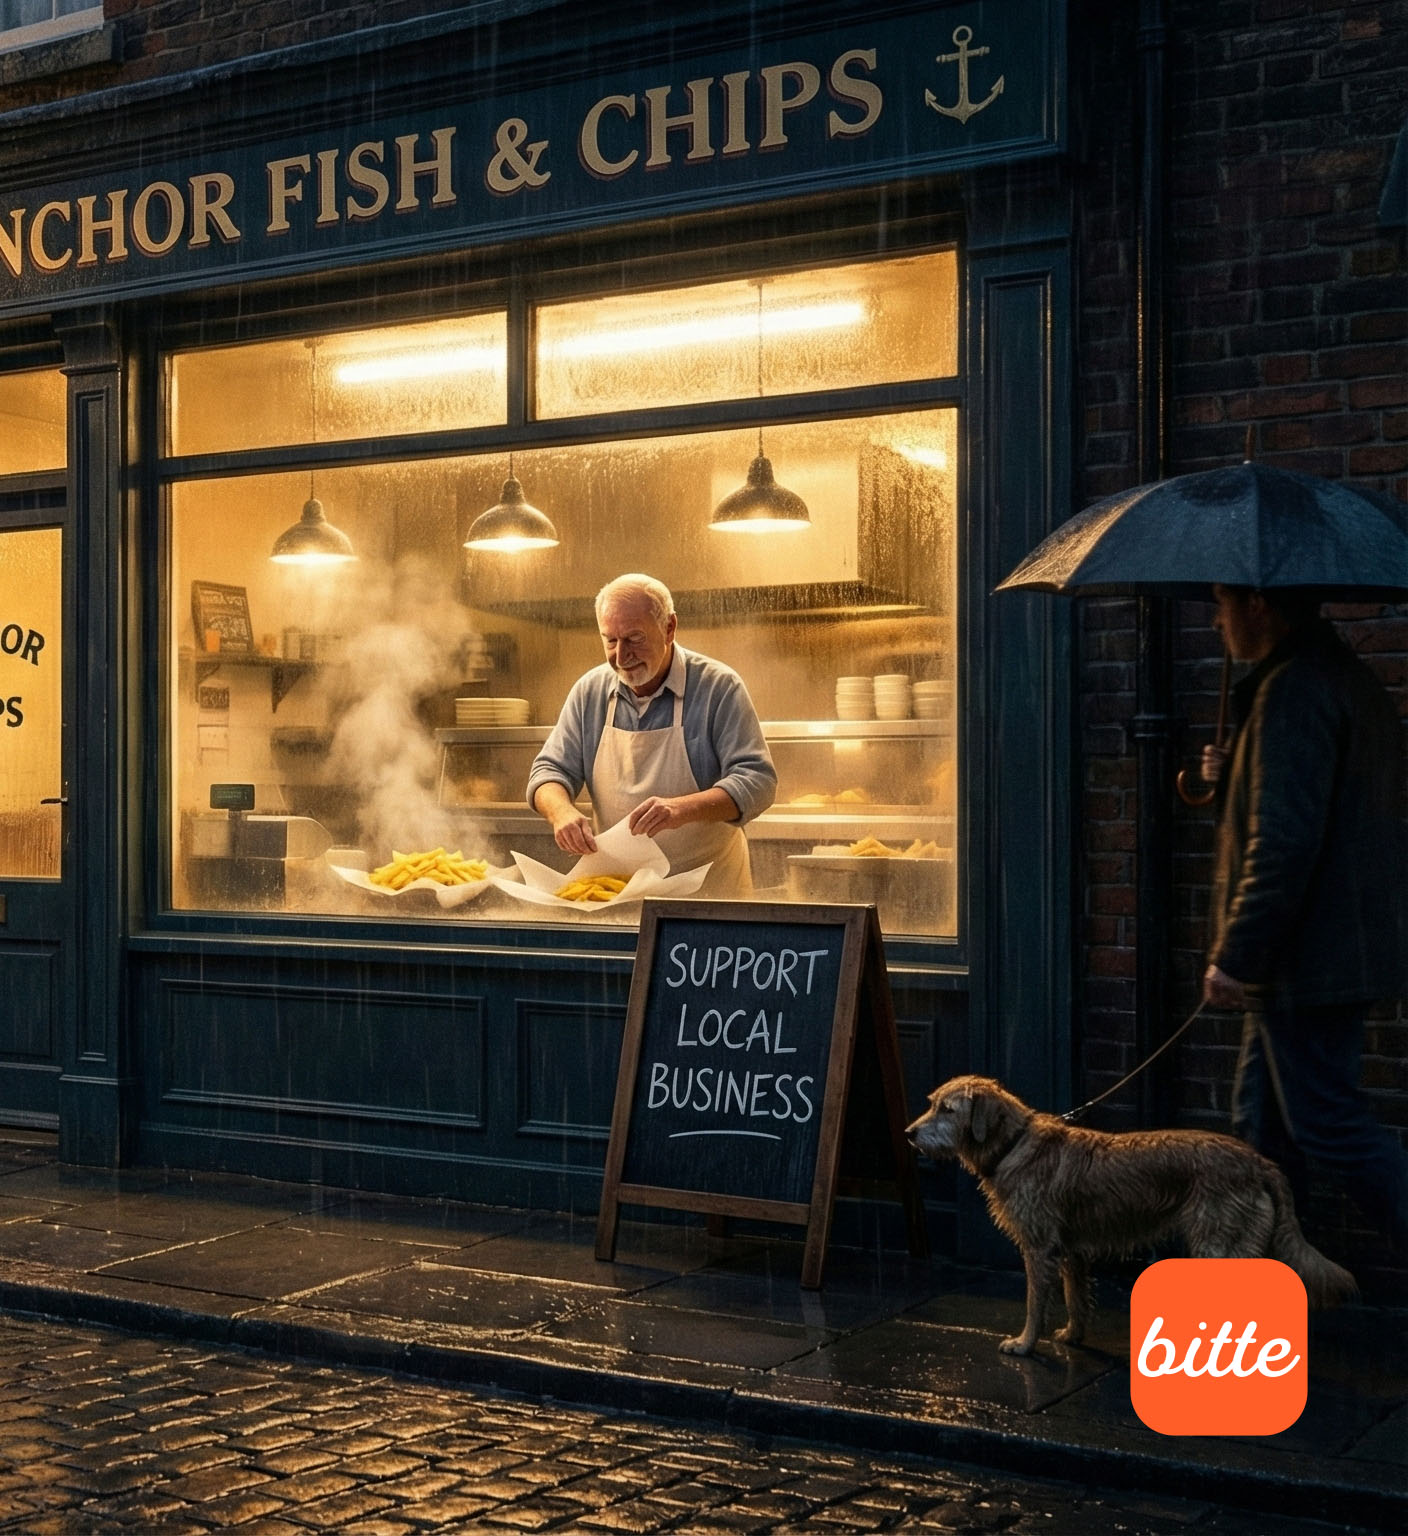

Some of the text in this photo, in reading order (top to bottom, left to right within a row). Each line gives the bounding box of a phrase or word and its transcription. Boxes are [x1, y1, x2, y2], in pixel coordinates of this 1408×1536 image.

[266, 126, 458, 234] FISH
[484, 116, 553, 195] &
[578, 47, 884, 181] CHIPS
[665, 942, 829, 998] SUPPORT
[676, 1003, 798, 1054] LOCAL
[647, 1062, 815, 1124] BUSINESS
